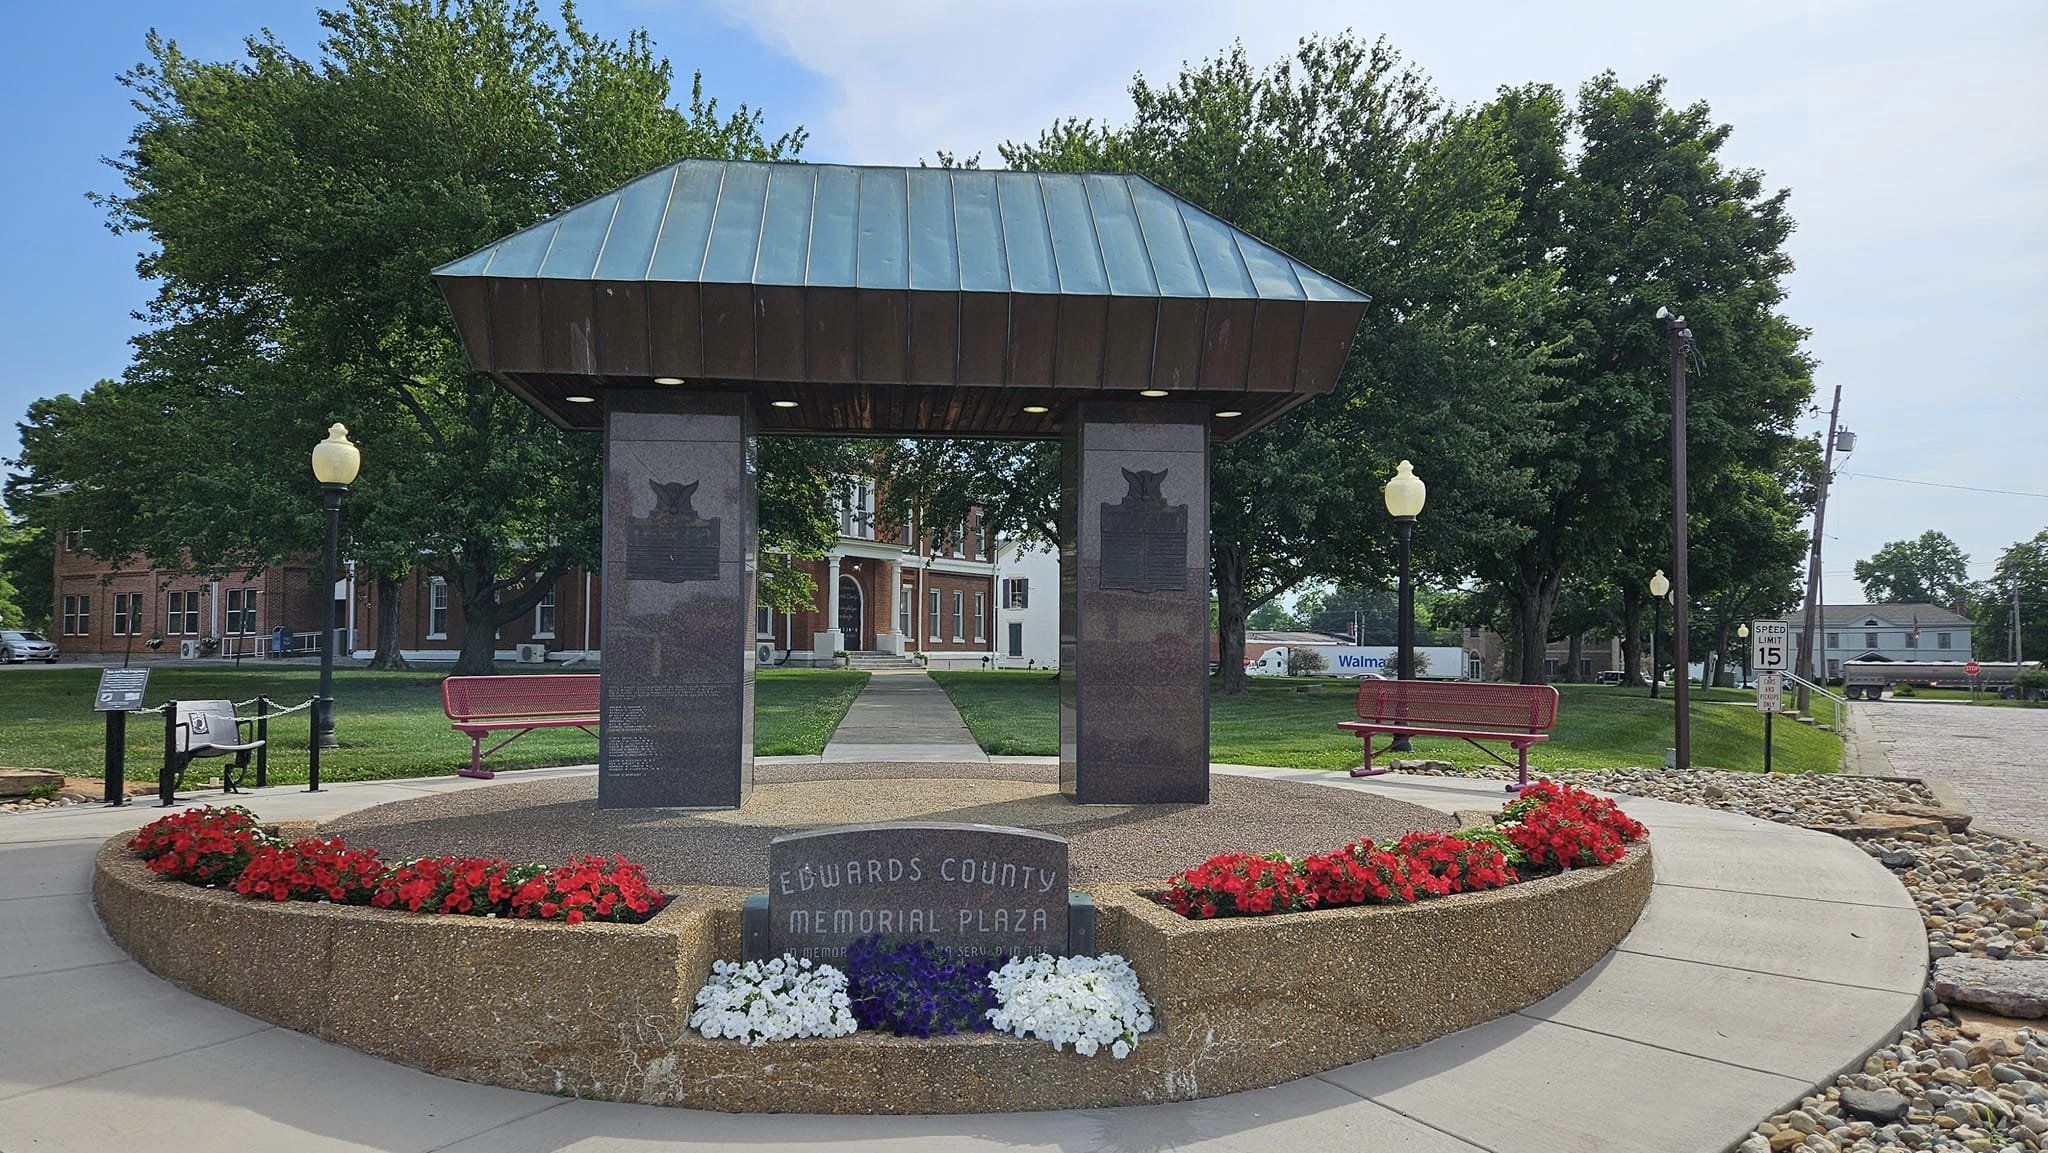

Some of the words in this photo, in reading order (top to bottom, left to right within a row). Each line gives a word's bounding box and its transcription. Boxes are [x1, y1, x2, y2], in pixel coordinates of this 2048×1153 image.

[1755, 625, 1786, 634] SPEED
[1758, 636, 1782, 644] LIMIT
[1338, 655, 1386, 668] Walma
[1759, 647, 1781, 665] 15
[780, 857, 921, 895] EDWARDS
[941, 858, 1056, 892] COUNTY
[789, 909, 940, 933] MEMORIAL
[960, 908, 1047, 932] PLAZA
[803, 947, 847, 958] MEMOR
[958, 946, 1002, 957] SERVD
